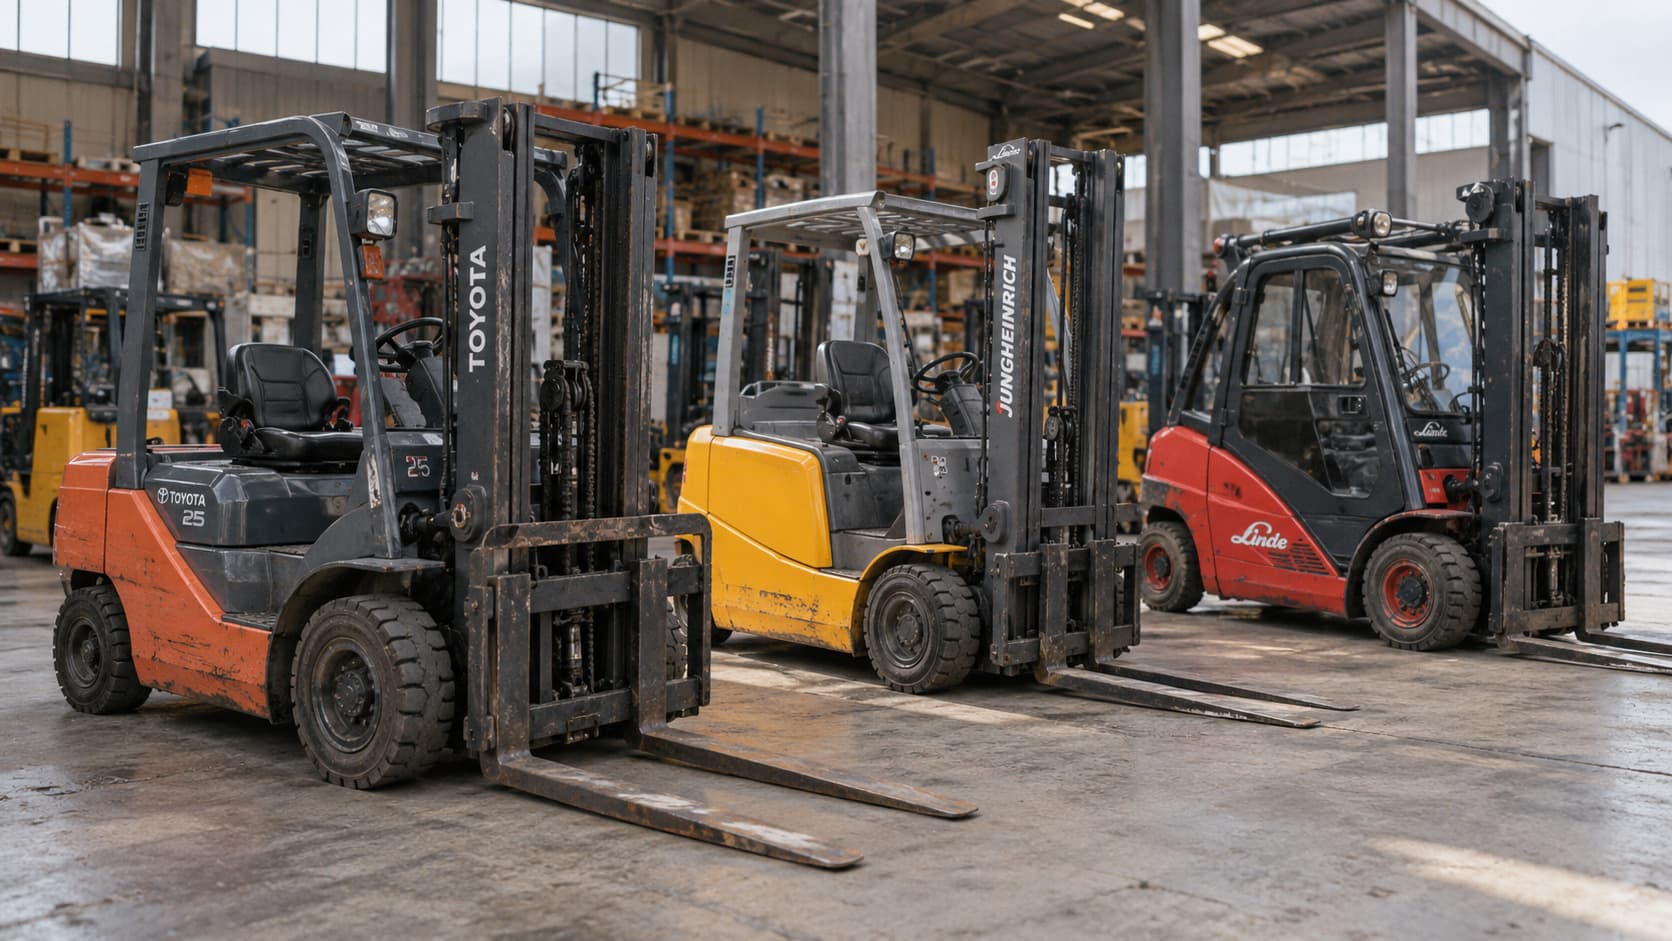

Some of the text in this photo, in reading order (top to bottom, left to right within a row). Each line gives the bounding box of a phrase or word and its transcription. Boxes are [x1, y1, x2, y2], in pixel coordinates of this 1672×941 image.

[469, 245, 486, 372] TOYOTA
[996, 255, 1016, 418] JUNGHEINRICH
[406, 456, 430, 478] 25
[169, 491, 206, 507] TOYOTA
[182, 510, 205, 527] 25
[1231, 521, 1288, 550] Linde
